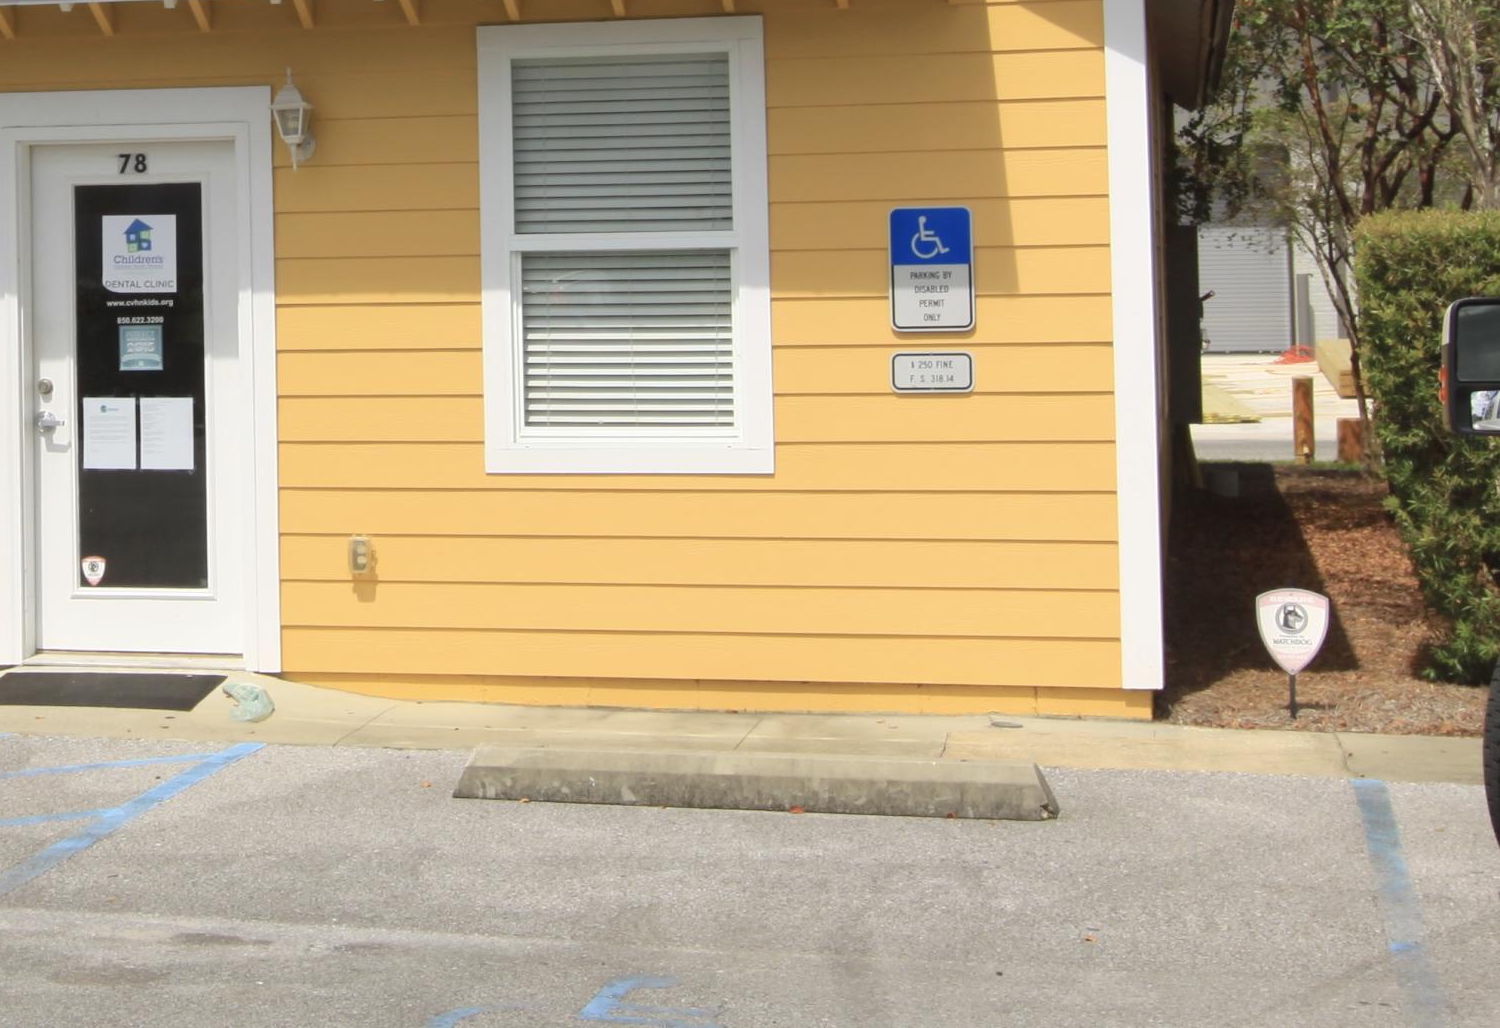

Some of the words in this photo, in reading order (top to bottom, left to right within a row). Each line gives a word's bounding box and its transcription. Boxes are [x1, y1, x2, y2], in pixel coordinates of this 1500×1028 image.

[119, 154, 147, 173] 78
[107, 299, 173, 308] www.cvhnkids.org
[918, 361, 932, 369] 250
